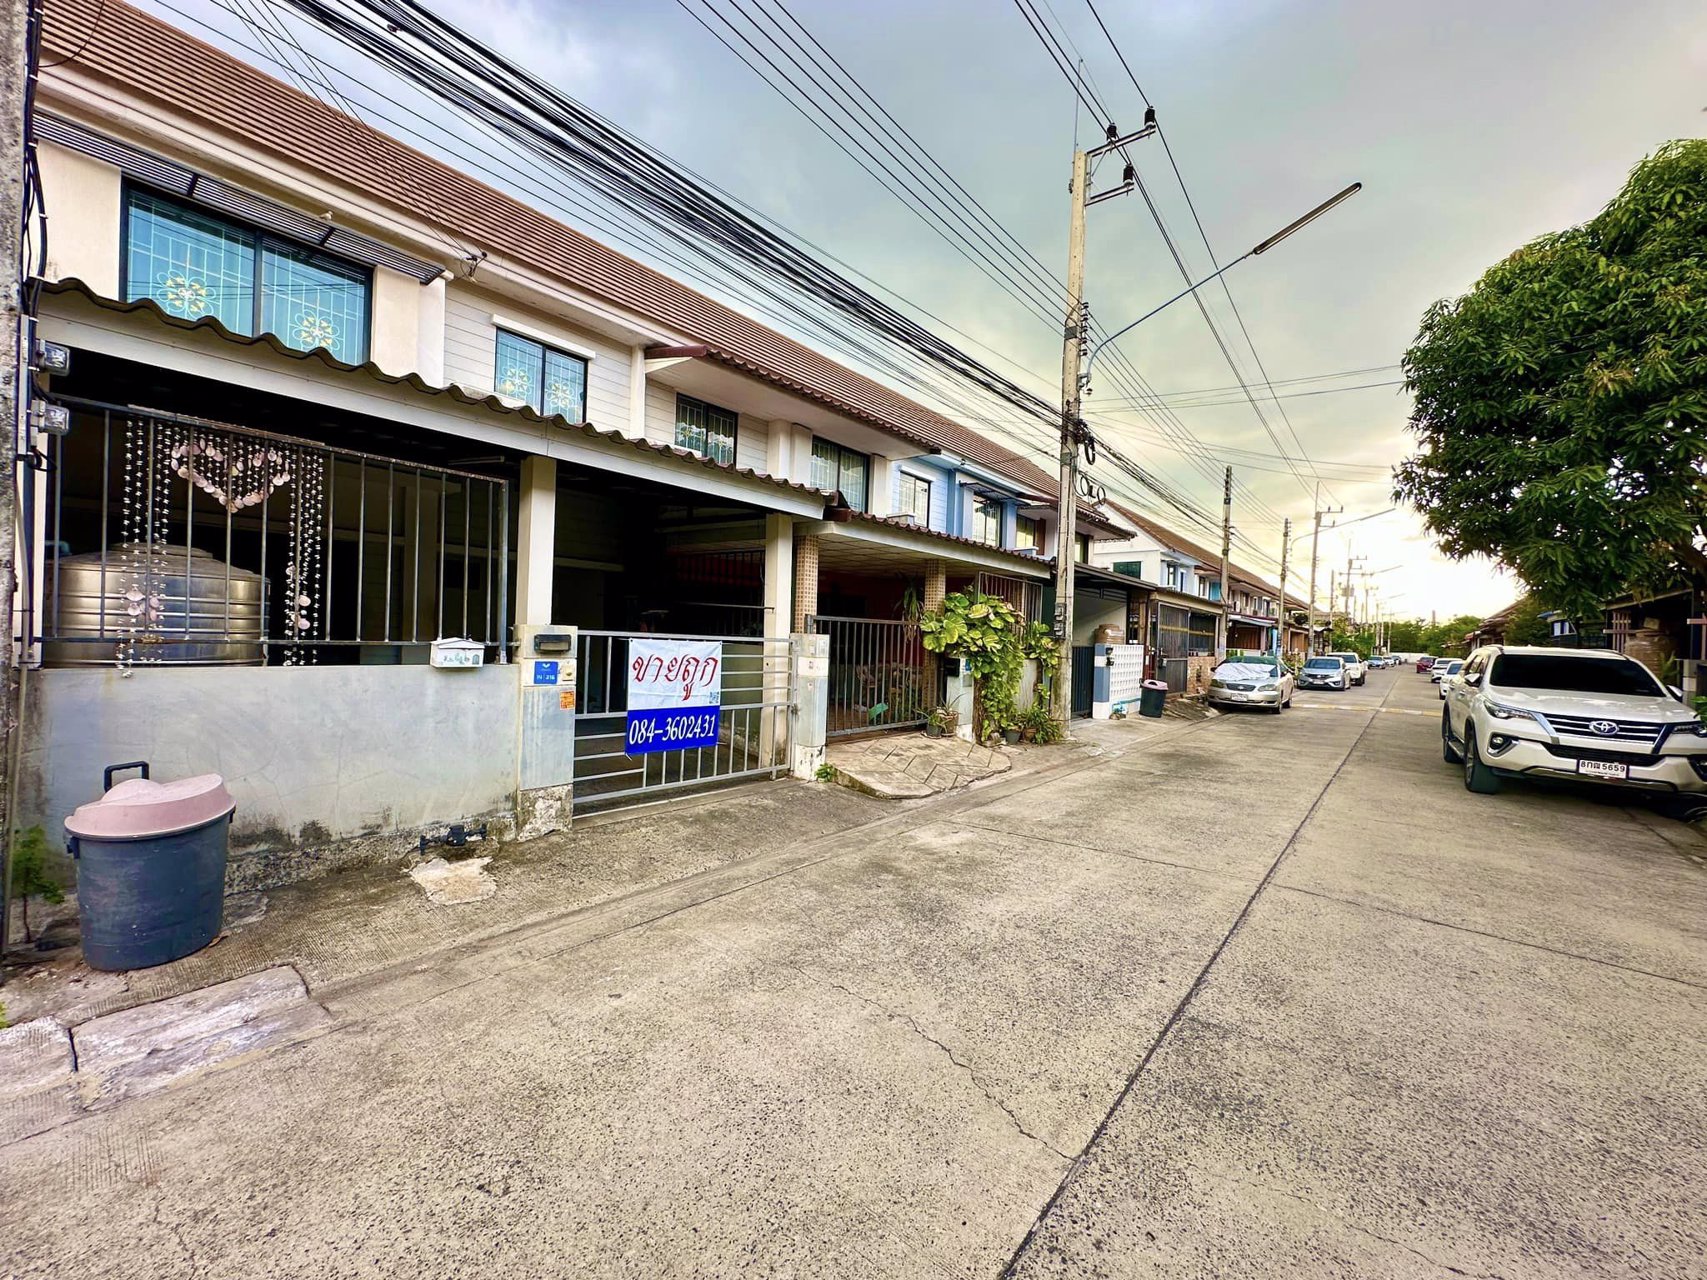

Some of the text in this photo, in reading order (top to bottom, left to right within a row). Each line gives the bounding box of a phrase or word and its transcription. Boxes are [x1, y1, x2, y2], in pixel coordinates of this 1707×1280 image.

[632, 654, 719, 701] ขายถูก
[629, 714, 716, 745] 084-3602431
[1601, 763, 1626, 773] 5659
